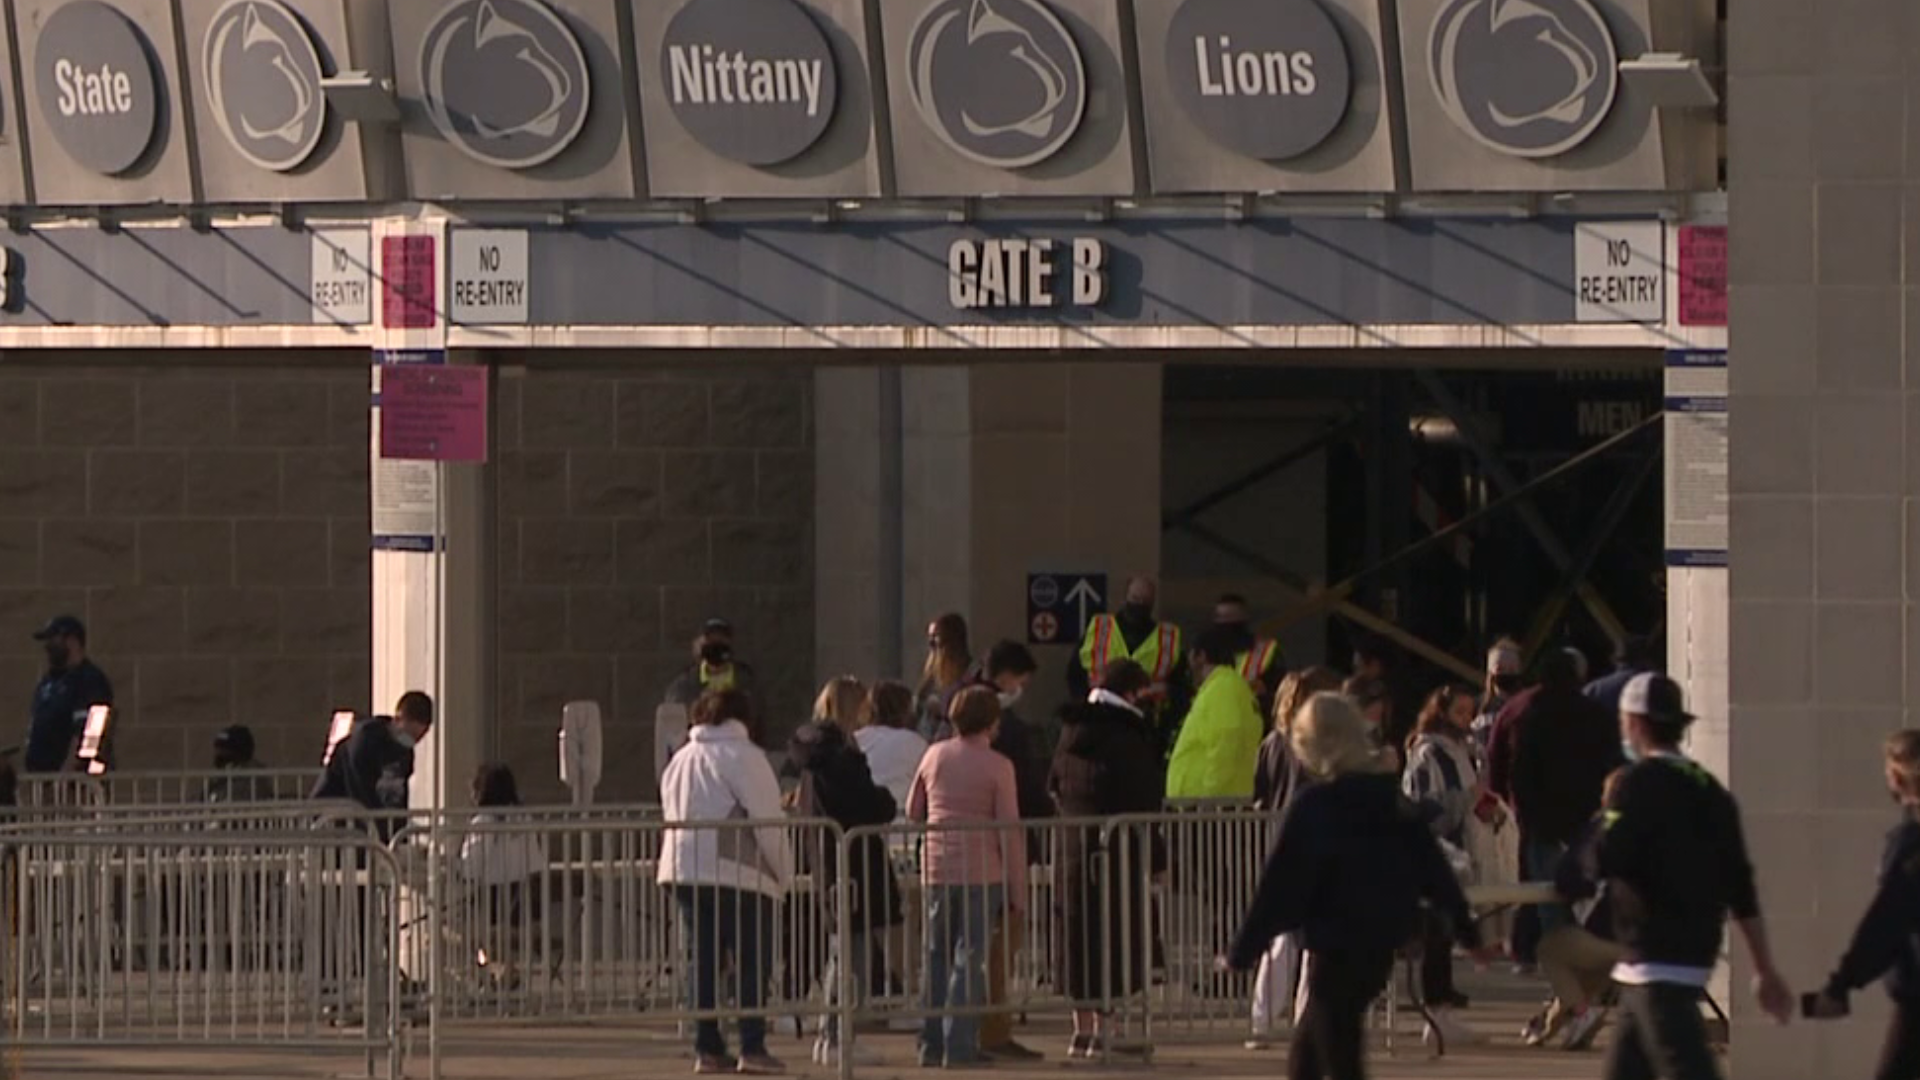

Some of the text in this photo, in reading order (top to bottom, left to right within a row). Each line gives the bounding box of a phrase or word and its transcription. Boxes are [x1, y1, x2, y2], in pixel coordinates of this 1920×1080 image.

[1195, 35, 1317, 96] Lions
[55, 58, 131, 116] State
[669, 45, 822, 116] Nittany
[332, 246, 349, 273] NO
[479, 245, 501, 272] NO
[1606, 239, 1630, 267] NO
[949, 237, 1102, 309] GATE B
[316, 281, 366, 306] RE-ENTRY
[456, 280, 525, 306] RE-ENTRY
[1581, 275, 1659, 303] RE-ENTRY
[1577, 400, 1642, 437] MEN
